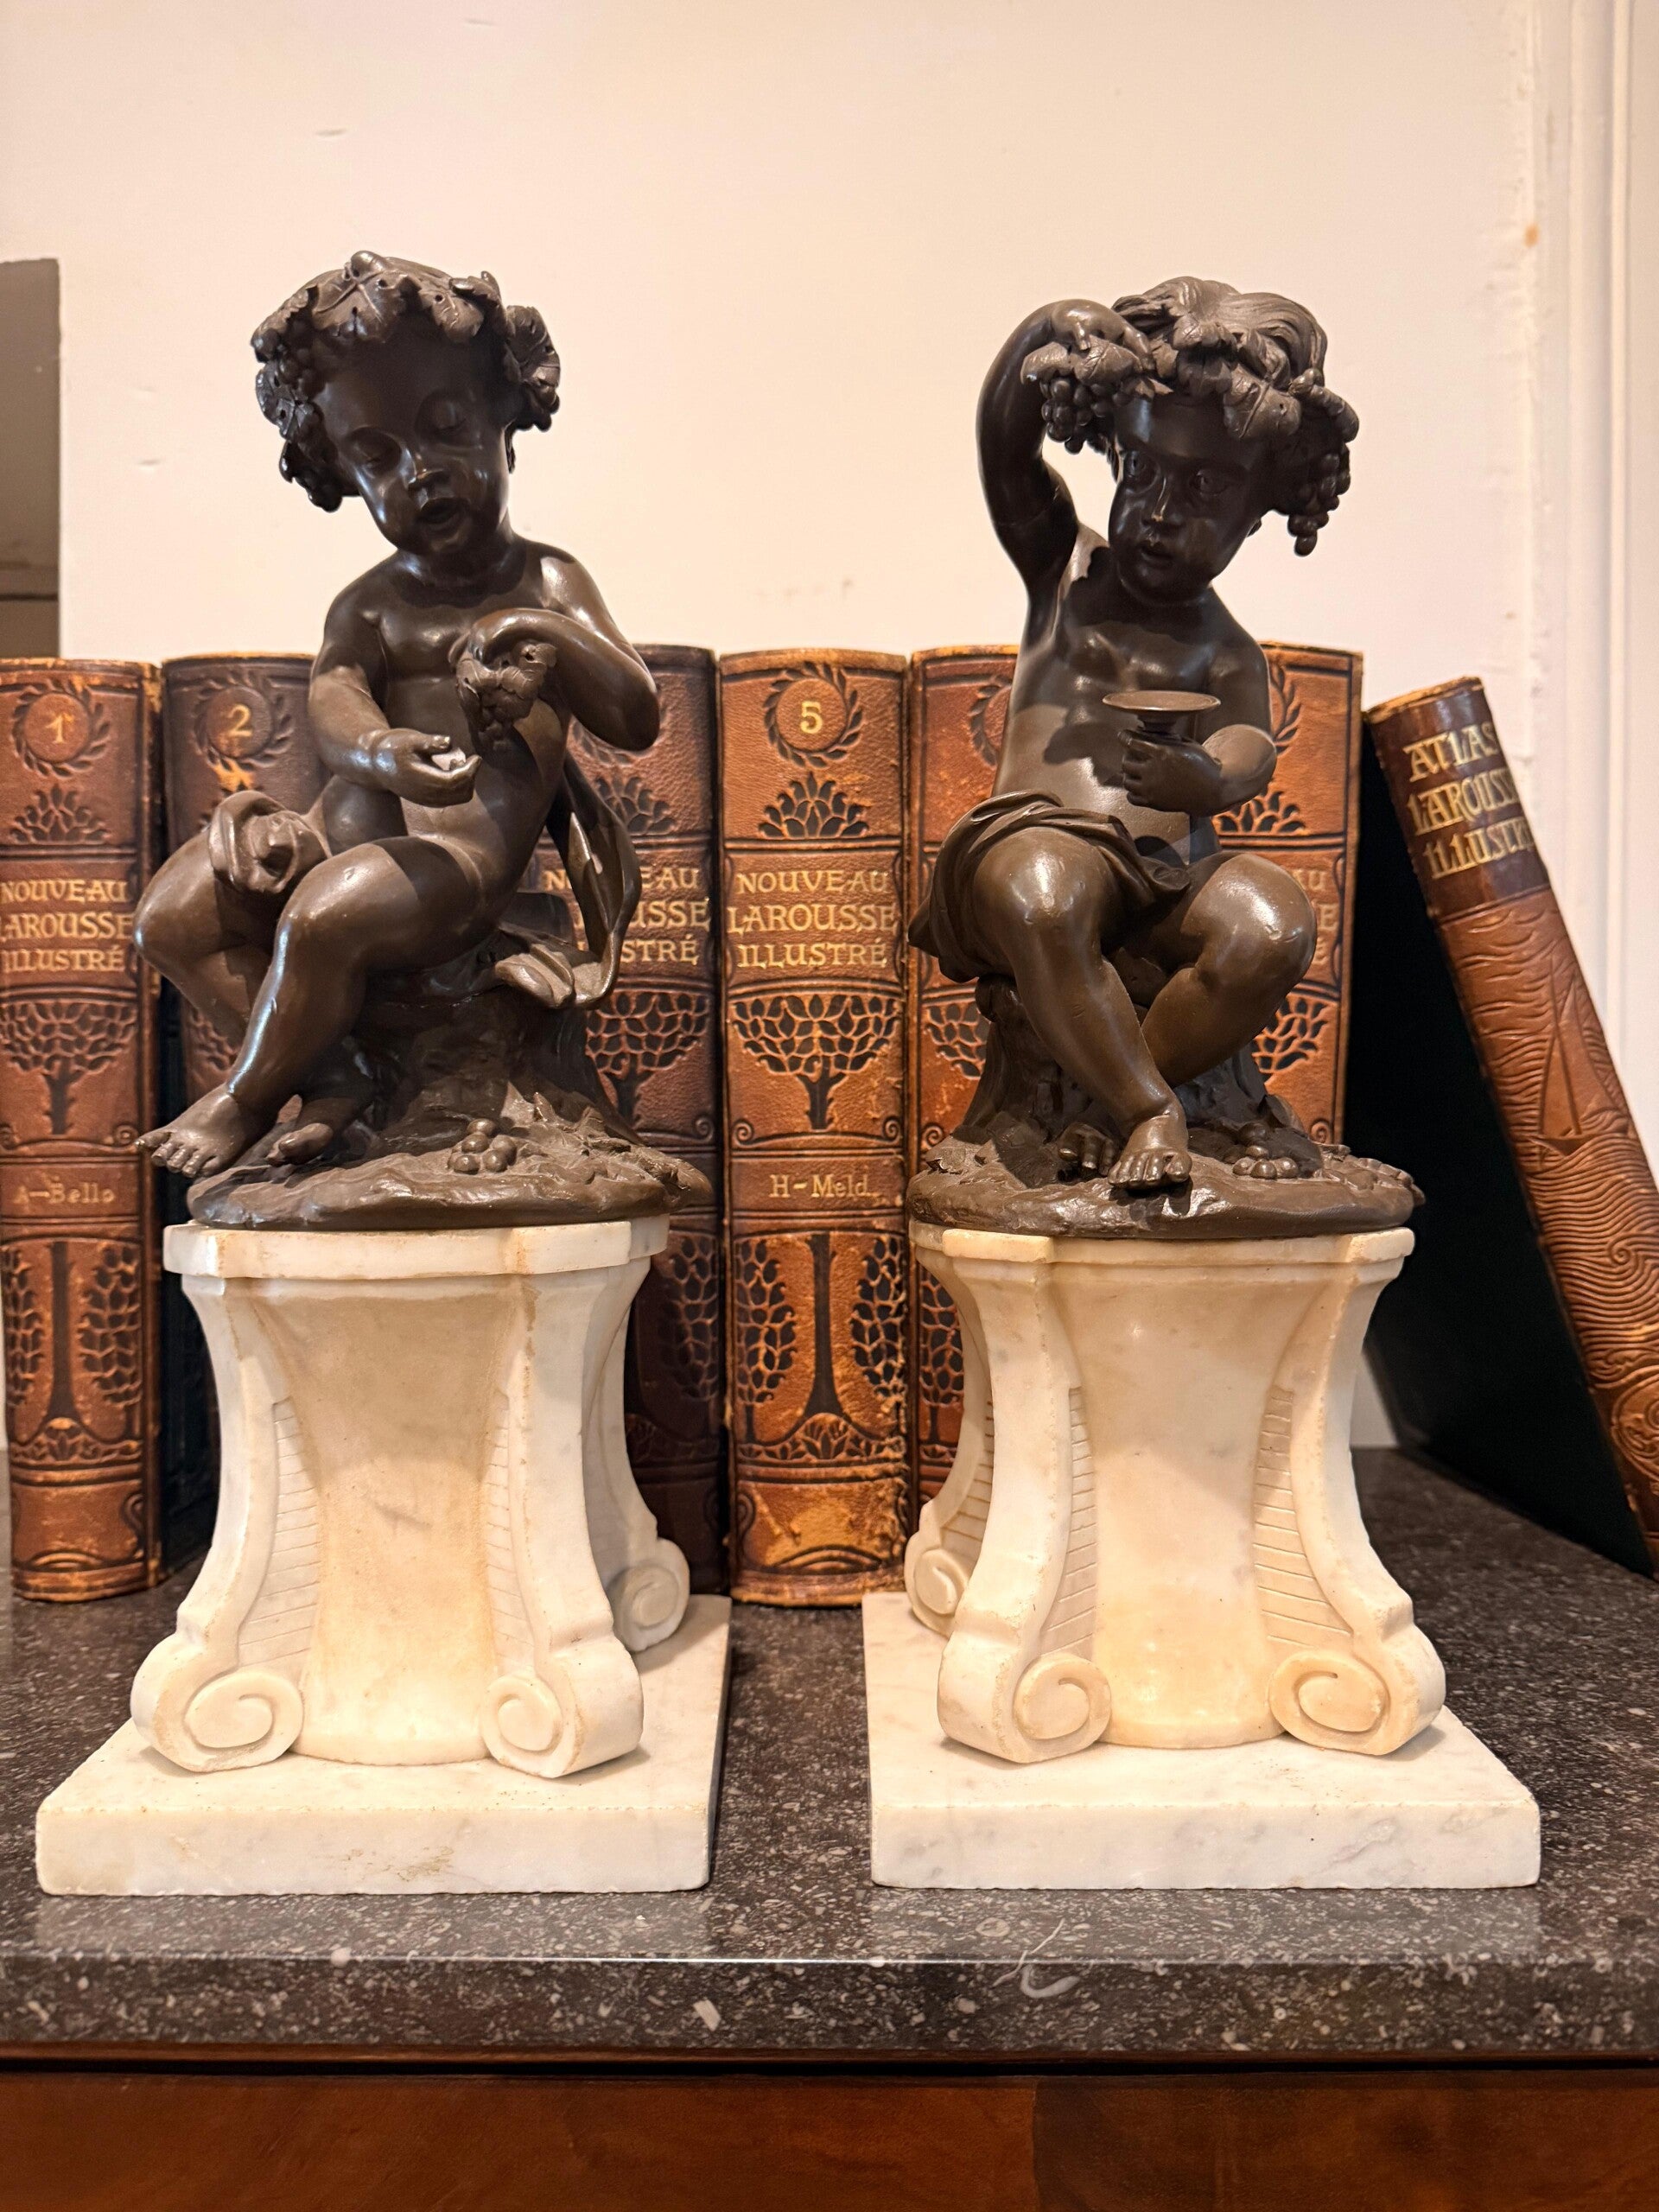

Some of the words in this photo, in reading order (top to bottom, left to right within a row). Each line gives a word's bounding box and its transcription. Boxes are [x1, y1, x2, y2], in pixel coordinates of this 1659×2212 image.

[45, 715, 67, 744] 1
[227, 704, 251, 736] 2
[800, 702, 823, 734] 5
[1403, 722, 1499, 782] ATLAS
[542, 868, 699, 891] NEAU
[737, 870, 887, 893] NOUVEAU
[0, 912, 133, 941] AROUSSE
[728, 904, 899, 936] LAROUSSE
[2, 945, 125, 973] ILLUSTRÉ
[737, 938, 887, 969] ILLUSTRÉ
